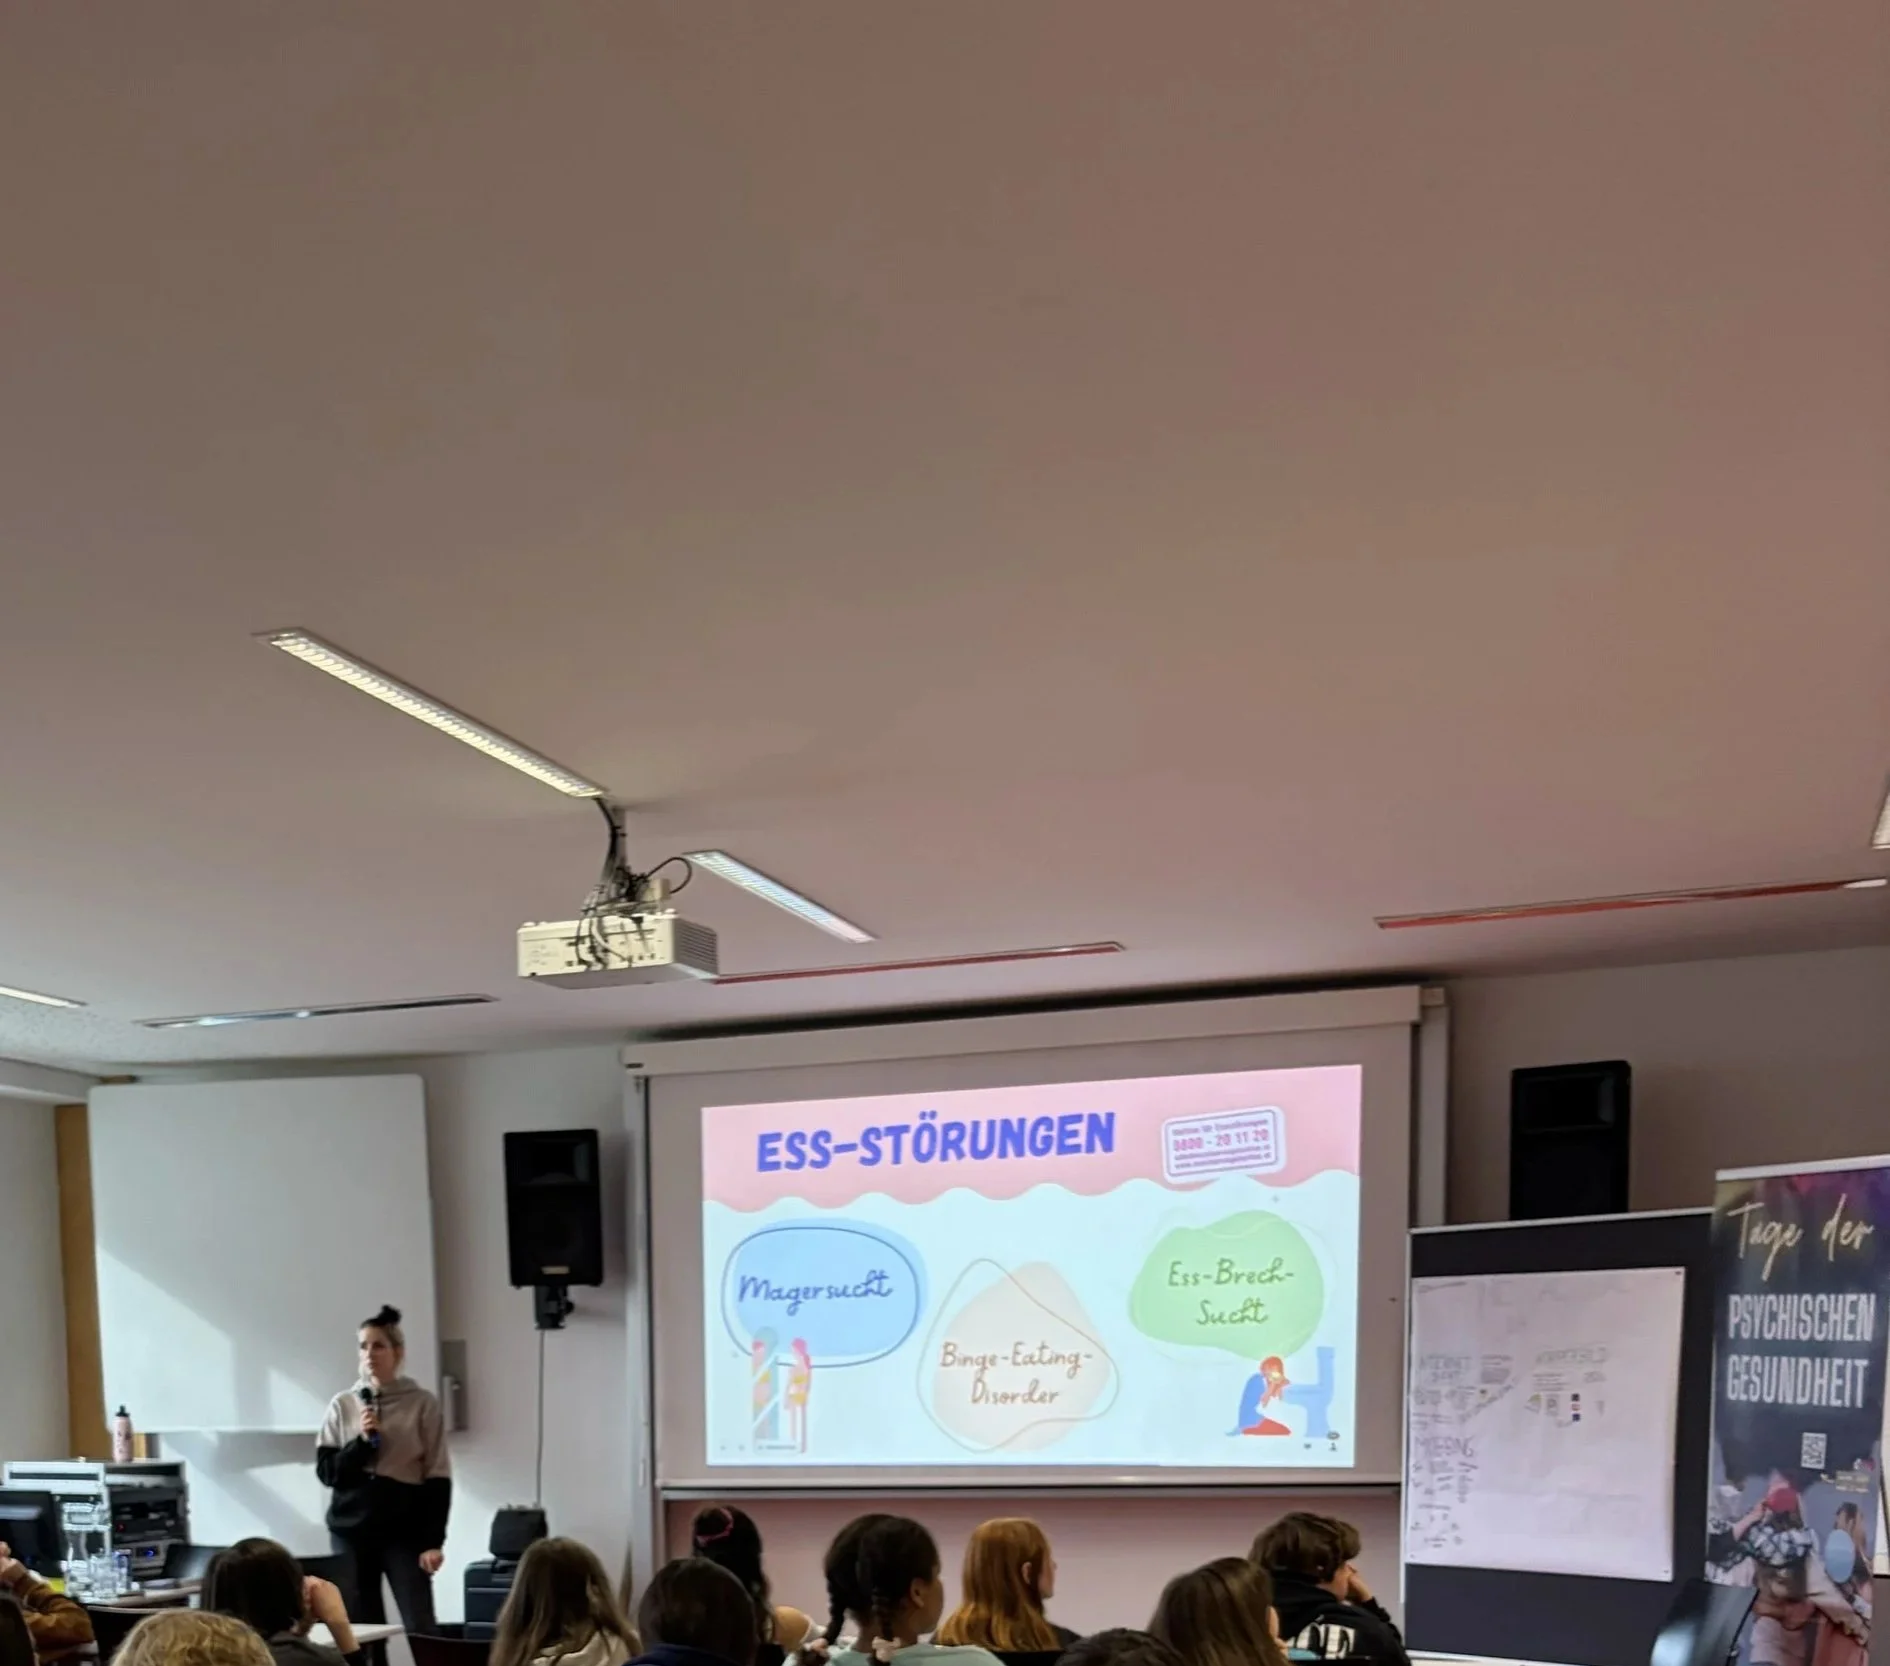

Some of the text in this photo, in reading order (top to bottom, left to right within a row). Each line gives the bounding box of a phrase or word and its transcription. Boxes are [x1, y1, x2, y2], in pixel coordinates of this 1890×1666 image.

[757, 1110, 1115, 1172] ESS-STÖRUNGEN
[1727, 1193, 1874, 1281] Tage der
[738, 1269, 893, 1317] Magersucht
[1168, 1256, 1294, 1287] Ess-Brech-
[1196, 1297, 1269, 1326] Sucht
[1727, 1293, 1877, 1342] PSYCHISCHEN
[940, 1340, 1094, 1380] Binge-Eating-
[1726, 1355, 1869, 1409] GESUNDHEIT
[971, 1376, 1059, 1404] Disorder
